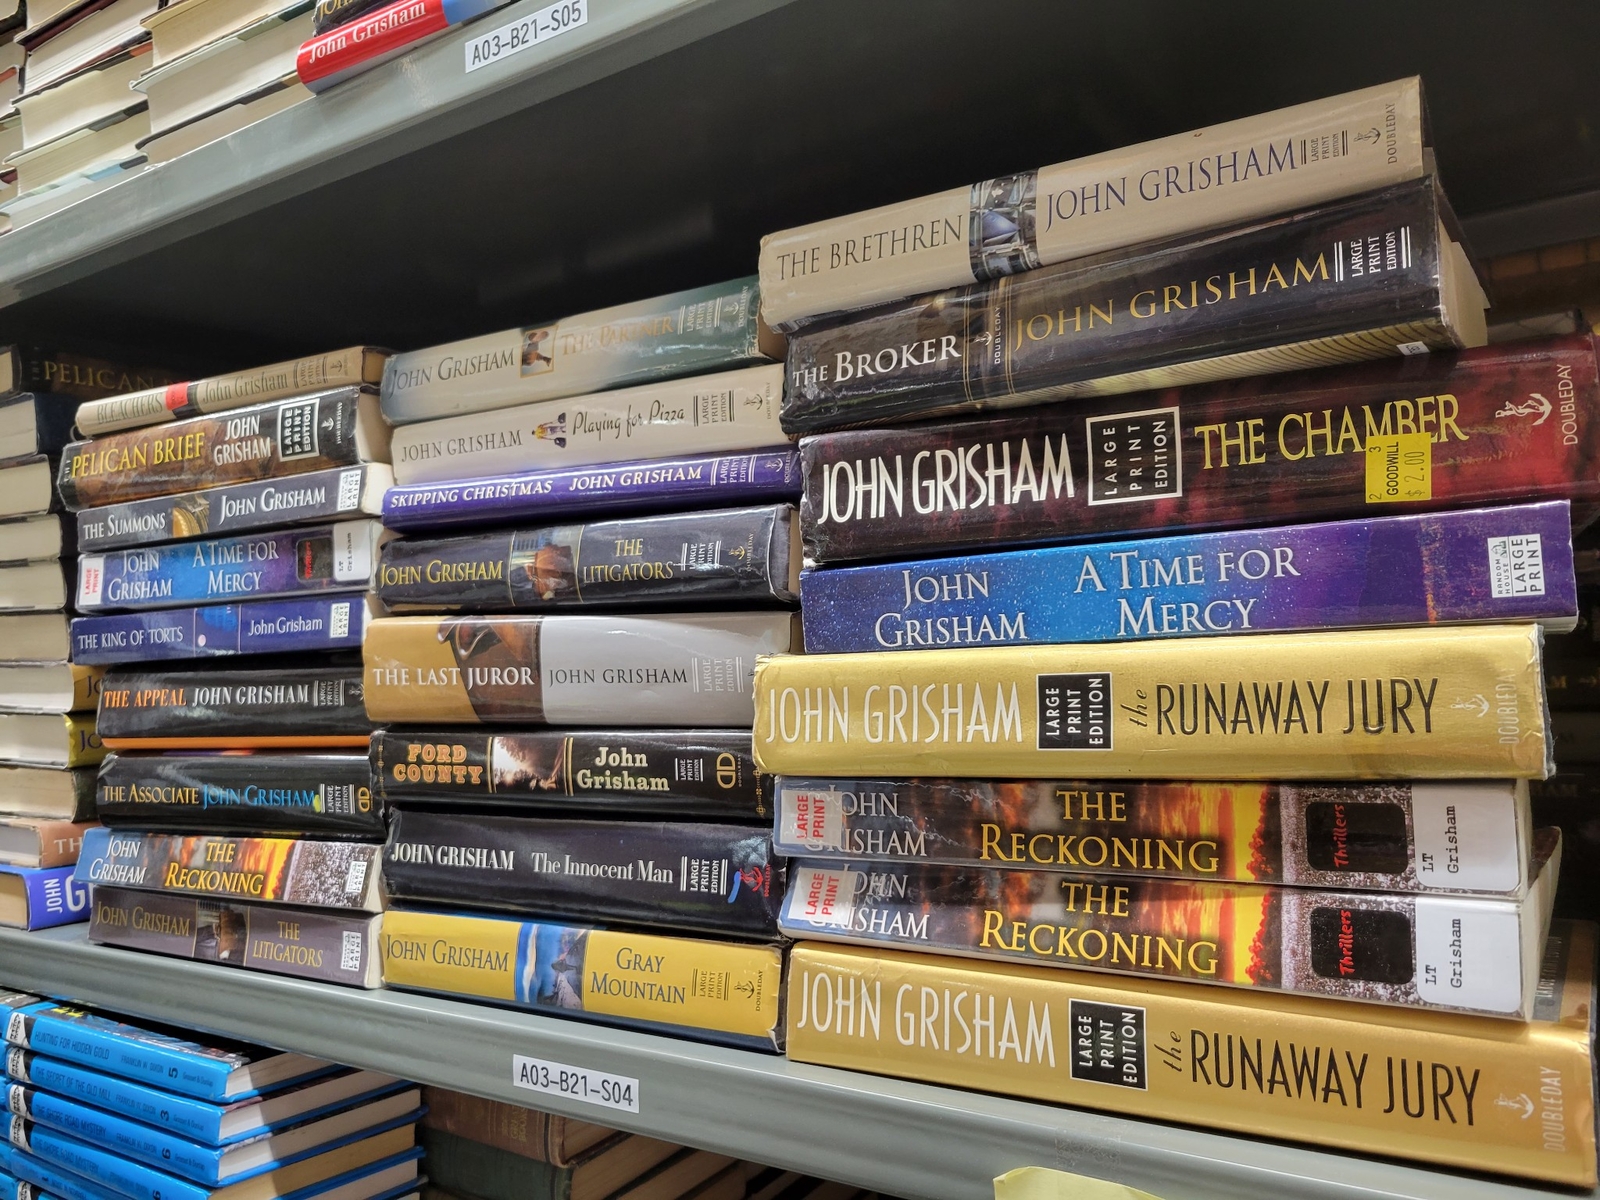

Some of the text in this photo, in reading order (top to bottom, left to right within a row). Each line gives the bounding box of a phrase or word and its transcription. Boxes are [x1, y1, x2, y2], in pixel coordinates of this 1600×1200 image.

[309, 36, 346, 63] John
[352, 2, 426, 43] Grisham
[472, 1, 582, 65] A03-B21-S05
[1386, 103, 1397, 164] DOUBLEDAY
[1046, 138, 1298, 233] JOHN GRISHAM
[777, 214, 963, 281] THE BRETHREN
[1351, 239, 1364, 277] LARGE
[1368, 236, 1381, 273] PRINT
[1386, 231, 1397, 270] EDITION
[561, 316, 674, 355] THE PARTNER
[44, 361, 154, 392] PELICAN
[389, 348, 515, 399] JOHN GRISHAM
[793, 335, 962, 387] THE BROKER
[202, 371, 288, 404] John Grisham
[1557, 364, 1578, 445] DOUBLEDAY
[96, 392, 163, 424] BLEACHERS
[303, 405, 311, 451] EDITION
[572, 400, 685, 441] Playing for Pizza
[213, 415, 271, 466] JOHN GRISHAM
[284, 409, 293, 454] LARGE
[293, 408, 302, 453] PRINT
[1195, 394, 1469, 469] THE CHAMBER
[71, 433, 205, 479] PELICAN BRIEF
[1103, 426, 1118, 496] LARGE
[1128, 425, 1142, 491] PRINT
[1153, 420, 1168, 489] EDITION
[1386, 442, 1399, 495] GOODWILL
[1404, 451, 1424, 482] 2.00
[390, 479, 553, 508] SKIPPING CHRISTMAS
[817, 433, 1075, 525] JOHN GRISHAM
[84, 512, 165, 540] THE SUMMONS
[218, 495, 255, 525] JOHN
[261, 487, 326, 512] GRISHAM
[193, 541, 279, 568] A TIME FOR
[615, 538, 644, 556] THE
[1512, 539, 1527, 593] LARGE
[1526, 539, 1541, 592] PRINT
[84, 567, 92, 595] LARGE
[91, 567, 99, 594] PRINT
[208, 570, 262, 595] MERCY
[583, 561, 674, 583] LITIGATORS
[902, 569, 989, 609] JOHN
[1074, 547, 1301, 593] A TIME FOR
[1495, 559, 1503, 594] RANDOM
[248, 619, 275, 637] John
[276, 616, 322, 633] Grisham
[875, 613, 1028, 648] GRISHAM
[1117, 596, 1258, 636] MERCY
[78, 627, 183, 649] THE KING OF TORTS
[104, 688, 187, 708] THE APPEAL
[192, 685, 309, 706] JOHN GRISHAM
[373, 666, 535, 690] THE LAST JUROR
[765, 682, 1023, 744] JOHN GRISHAM
[1046, 687, 1060, 736] LARGE
[1067, 688, 1081, 734] PRINT
[1089, 678, 1103, 745] EDITION
[1120, 677, 1438, 735] the RUNAWAY JURY
[407, 744, 467, 763] FORD
[393, 764, 483, 784] COUNTY
[104, 785, 199, 804] THE ASSOCIATE
[1056, 790, 1126, 822] THE
[797, 794, 809, 839] LARGE
[813, 797, 825, 838] PRINT
[1333, 804, 1349, 868] Thrillers
[206, 843, 235, 863] THE
[392, 842, 515, 870] JOHN GRISHAM
[980, 823, 1219, 872] RECKONING
[1445, 805, 1459, 874] Grisham
[165, 864, 264, 895] RECKONING
[531, 852, 673, 883] The Innocent Man
[690, 858, 699, 891] LARGE
[700, 859, 710, 892] PRINT
[711, 860, 719, 894] EDITION
[842, 864, 908, 898] OHN
[1422, 853, 1433, 873] LT
[43, 878, 62, 913] JOHN
[806, 873, 824, 915] LARGE
[821, 876, 839, 916] PRINT
[1062, 882, 1129, 917] THE
[96, 902, 190, 937] JOHN GRISHAM
[278, 921, 300, 941] THE
[253, 941, 323, 967] LITIGATORS
[617, 948, 665, 973] GRAY
[980, 910, 1218, 974] RECKONING
[1339, 910, 1354, 975] Thrillers
[1450, 918, 1462, 988] Grisham
[591, 972, 686, 1004] MOUNTAIN
[1426, 964, 1437, 985] LT
[797, 970, 1055, 1068] JOHN GRISHAM
[35, 1031, 178, 1079] HUNTING FOR HIDDEN GOLD 5
[1078, 1015, 1092, 1067] LARGE
[1100, 1020, 1114, 1068] PRINT
[1123, 1012, 1136, 1083] EDITION
[520, 1063, 633, 1106] A03-B21-S04
[1154, 1029, 1480, 1126] the RUNAWAY JURY
[160, 1110, 169, 1121] 3
[1540, 1066, 1566, 1152] DOUBLEDAY
